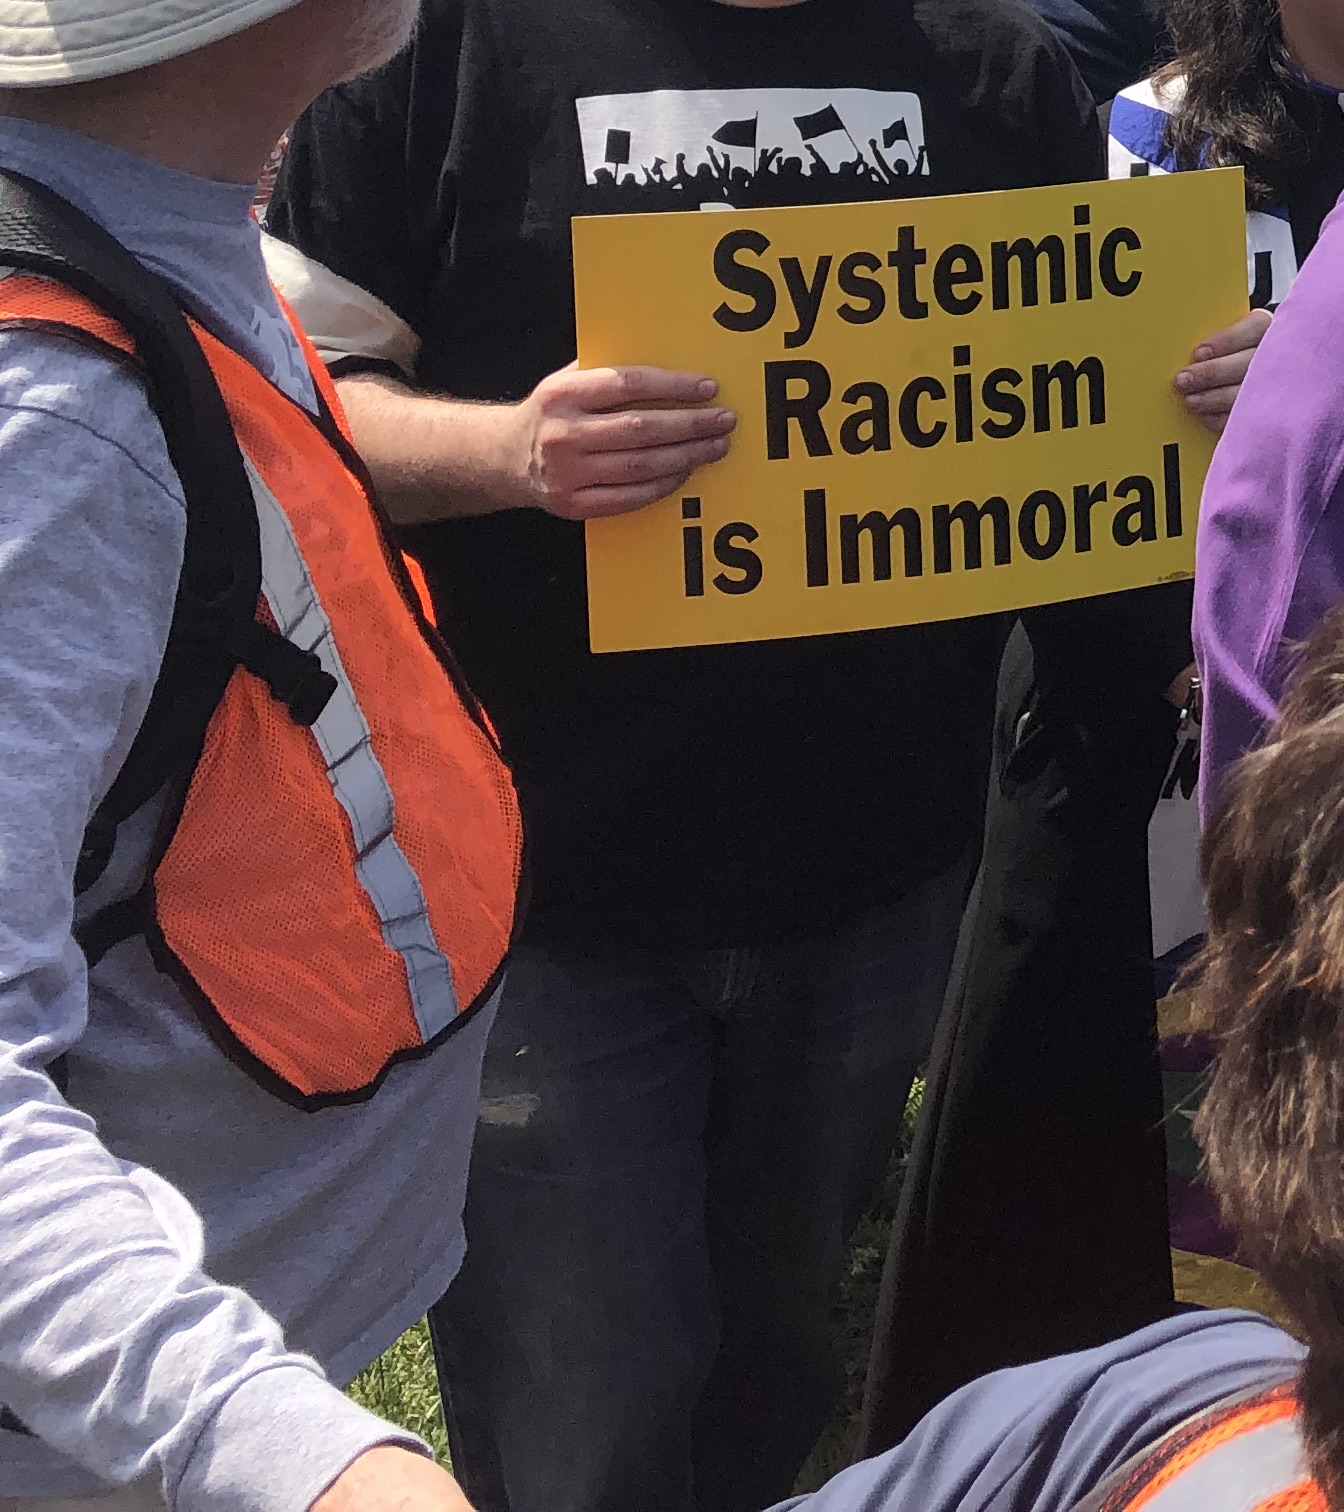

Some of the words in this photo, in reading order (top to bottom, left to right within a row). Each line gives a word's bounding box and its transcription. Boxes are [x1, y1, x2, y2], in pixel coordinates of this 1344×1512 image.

[713, 205, 1142, 347] Systemic
[765, 345, 1106, 461] Racism
[683, 497, 763, 597] is
[805, 443, 1182, 588] Immoral
